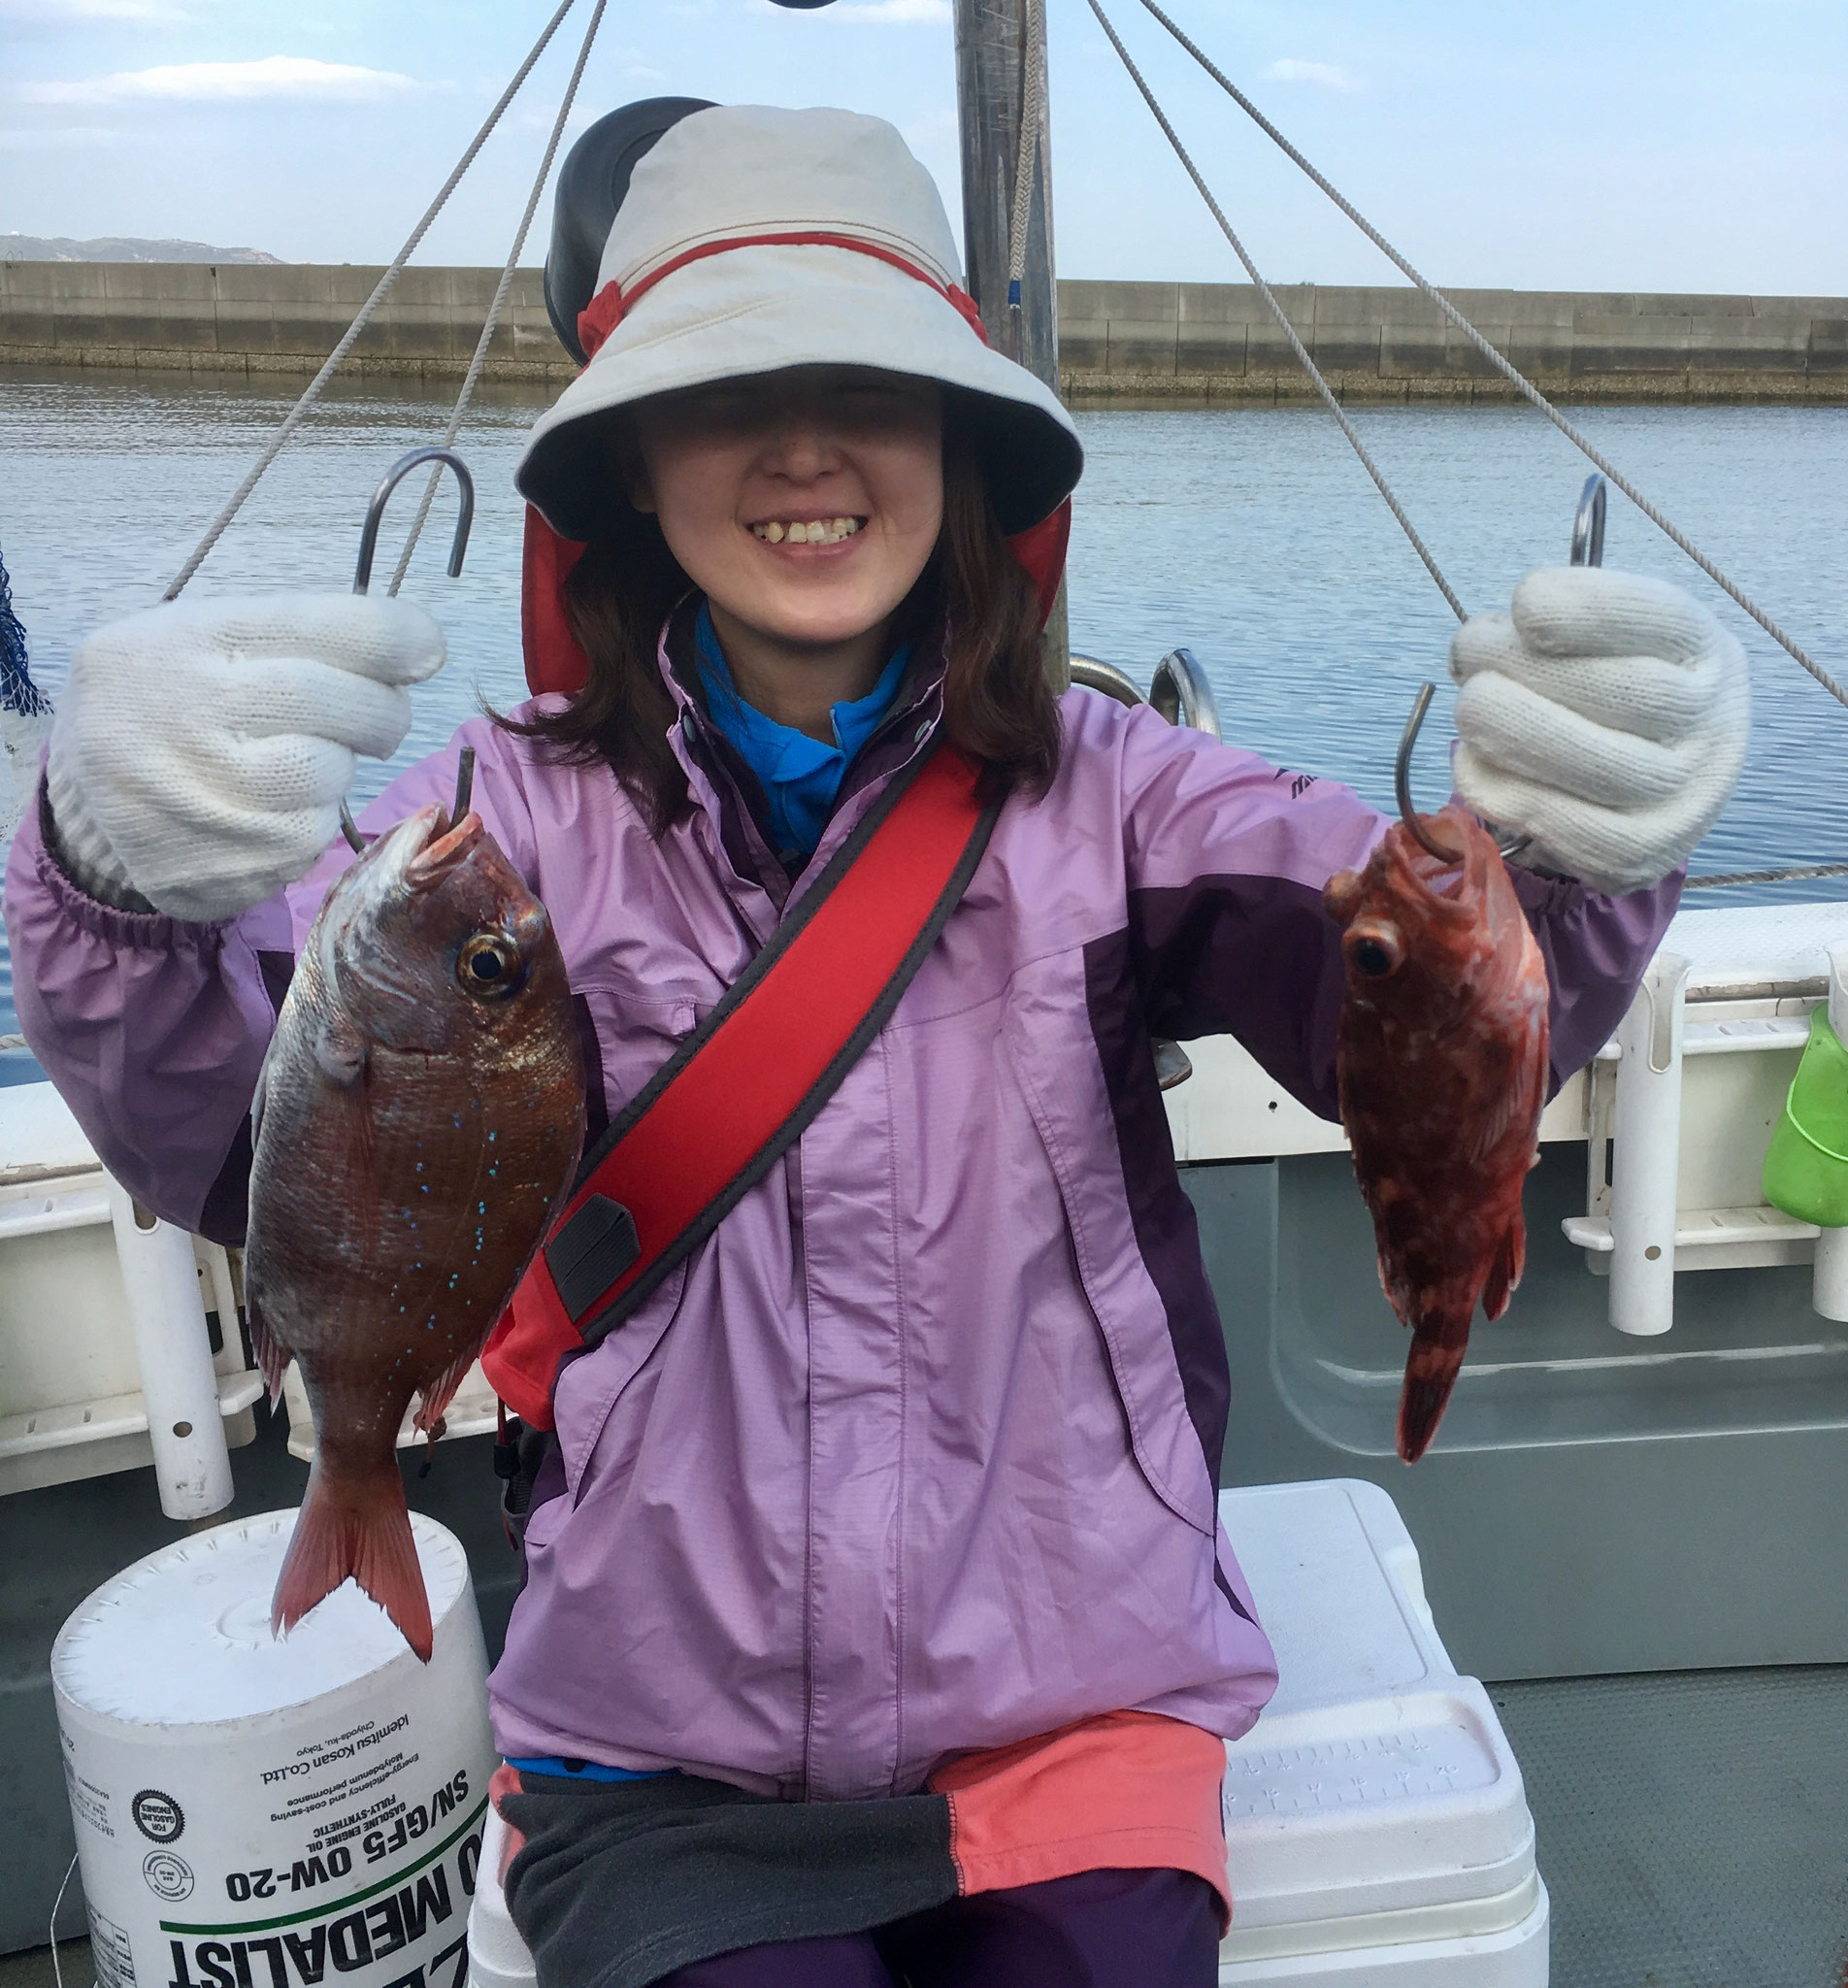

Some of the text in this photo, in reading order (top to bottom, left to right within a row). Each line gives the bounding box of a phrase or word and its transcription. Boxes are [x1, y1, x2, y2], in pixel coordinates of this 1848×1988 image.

[296, 1720, 375, 1757] Chiyoda-ku, Tokyo
[356, 1713, 410, 1751] Idemitsu
[286, 1751, 404, 1806] Molybdenum performance
[313, 1745, 355, 1769] Kosan
[141, 1804, 172, 1815] ENGINES
[270, 1752, 420, 1822] Energy-efficiency and cost-saving
[141, 1811, 176, 1824] GASOLINE
[151, 1822, 167, 1833] FOR
[306, 1801, 407, 1854] GASOLINE ENGINE OIL
[313, 1794, 397, 1839] FULLY-SYNTHETIC
[362, 1769, 470, 1865] SN/GF5
[225, 1845, 352, 1903] 0W-20
[168, 1862, 453, 1988] MEDALIST
